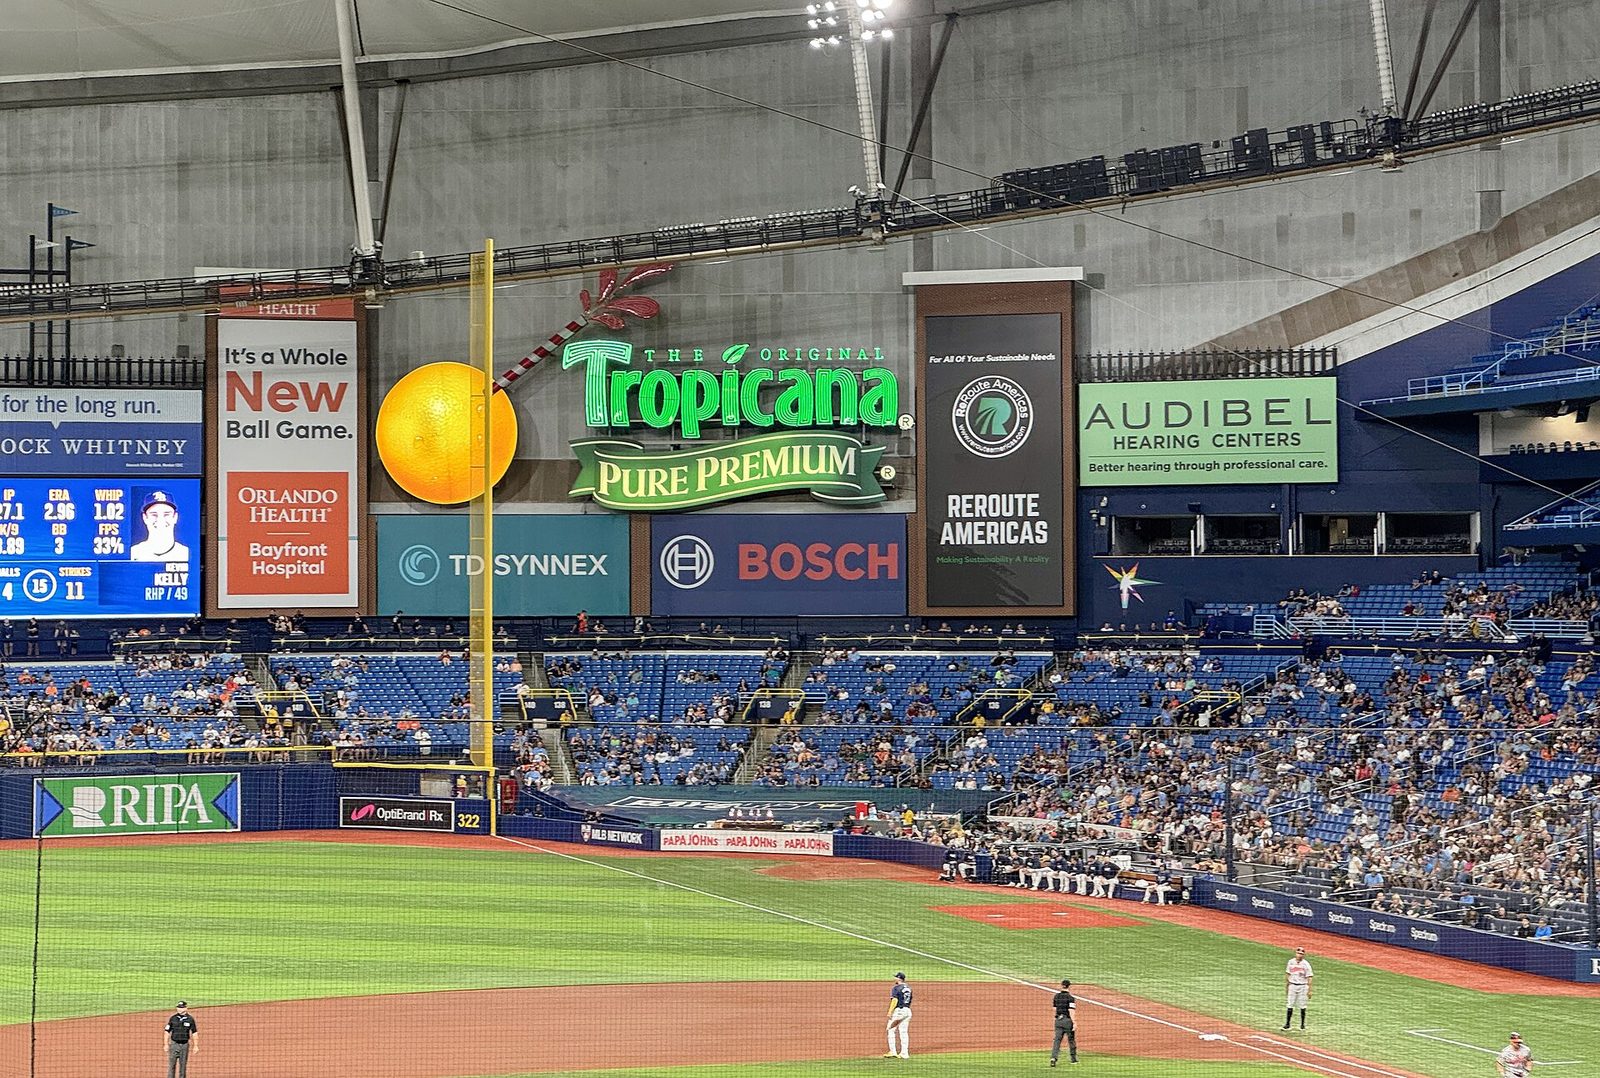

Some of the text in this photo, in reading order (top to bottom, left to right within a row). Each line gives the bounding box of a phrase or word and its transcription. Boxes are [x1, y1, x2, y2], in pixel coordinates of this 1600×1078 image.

[258, 304, 317, 315] HEALTH
[225, 347, 348, 365] It's a Whole
[644, 347, 884, 362] THE ORIGINAL
[943, 355, 954, 363] All
[955, 355, 966, 363] Of
[967, 355, 985, 363] Your
[986, 354, 1030, 362] Sustainable
[1030, 353, 1056, 361] Needs
[225, 370, 348, 413] New
[562, 339, 899, 438] Tropicana
[3, 394, 161, 417] for the long run.
[955, 378, 1028, 419] ReRoute Americas
[1084, 398, 1332, 430] AUDIBEL
[226, 420, 353, 439] Ball Game.
[0, 438, 188, 455] OCK WHITNEY
[1113, 432, 1301, 450] HEARING CENTERS
[598, 460, 688, 498] PURE
[695, 445, 857, 493] PREMIUM
[1089, 459, 1328, 473] Better hearing through professional care.
[3, 489, 15, 501] IP
[48, 489, 70, 501] ERA
[94, 489, 123, 501] WHIP
[238, 487, 338, 504] ORLANDO
[44, 503, 75, 520] 2.96
[93, 503, 124, 520] 1.02
[947, 493, 1040, 518] REROUTE
[249, 506, 328, 523] HEALTH
[52, 523, 67, 535] BB
[98, 523, 120, 535] FPS
[940, 521, 1048, 545] AMERICAS
[54, 537, 64, 554] 3
[93, 537, 124, 554] 33%
[249, 541, 328, 560] Bayfront
[449, 554, 609, 576] TD SYNNEX
[738, 543, 899, 581] BOSCH
[936, 556, 963, 564] Making
[252, 560, 325, 579] Hospital
[32, 579, 48, 594] 15
[154, 573, 189, 586] KELLY
[2, 582, 13, 600] 4
[65, 581, 85, 600] 11
[145, 587, 165, 600] RHP
[174, 587, 188, 600] 49
[109, 783, 213, 827] RIPA
[377, 807, 443, 821] OptiBrand Rx
[457, 813, 480, 828] 322
[591, 829, 643, 845] MLB NETWORK
[663, 835, 686, 845] PAPA
[726, 837, 747, 847] PAPA
[784, 838, 806, 849] PAPA
